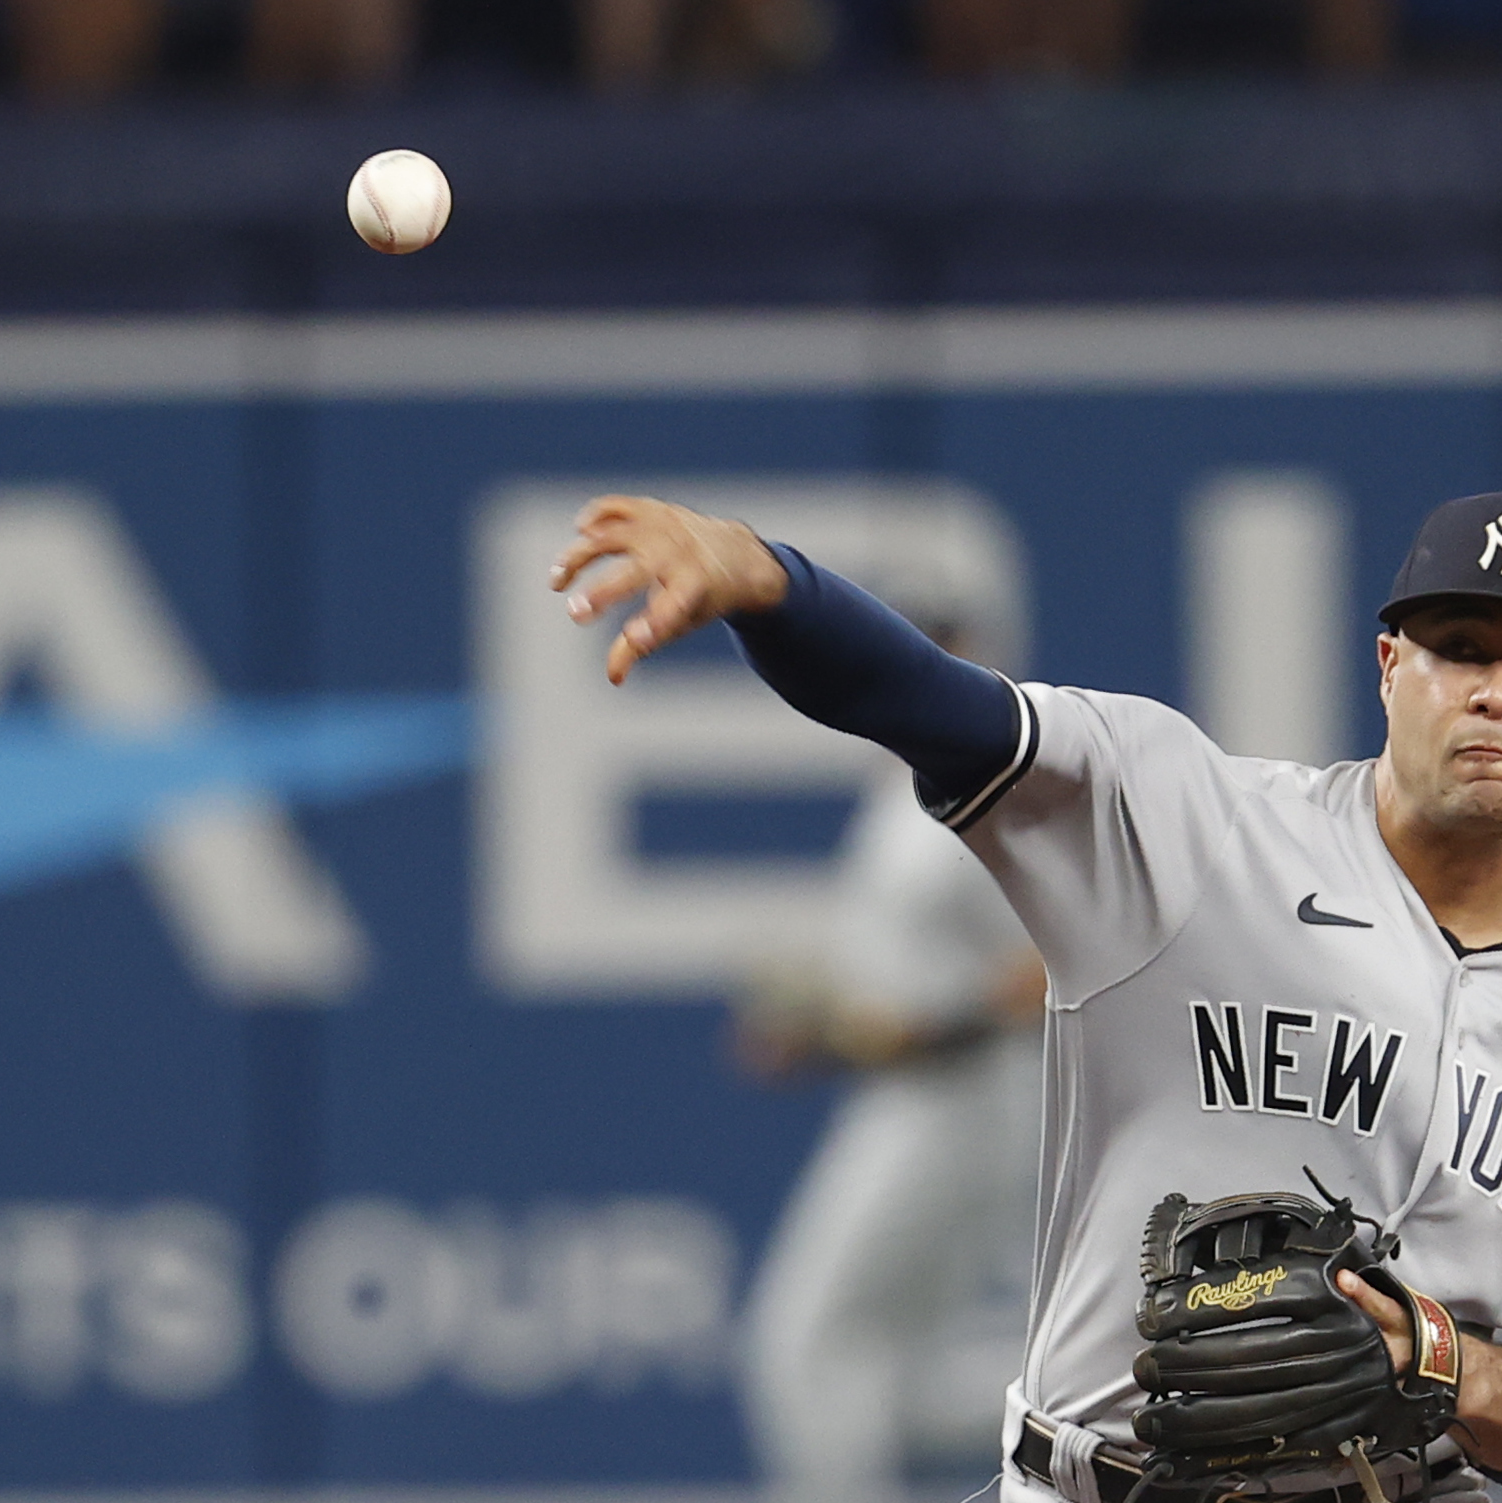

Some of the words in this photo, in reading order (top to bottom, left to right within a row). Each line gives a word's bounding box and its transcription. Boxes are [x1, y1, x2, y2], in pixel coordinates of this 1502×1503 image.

[1189, 1001, 1408, 1138] NEW
[273, 1196, 737, 1398] OUR
[1187, 1265, 1288, 1310] Rawlings
